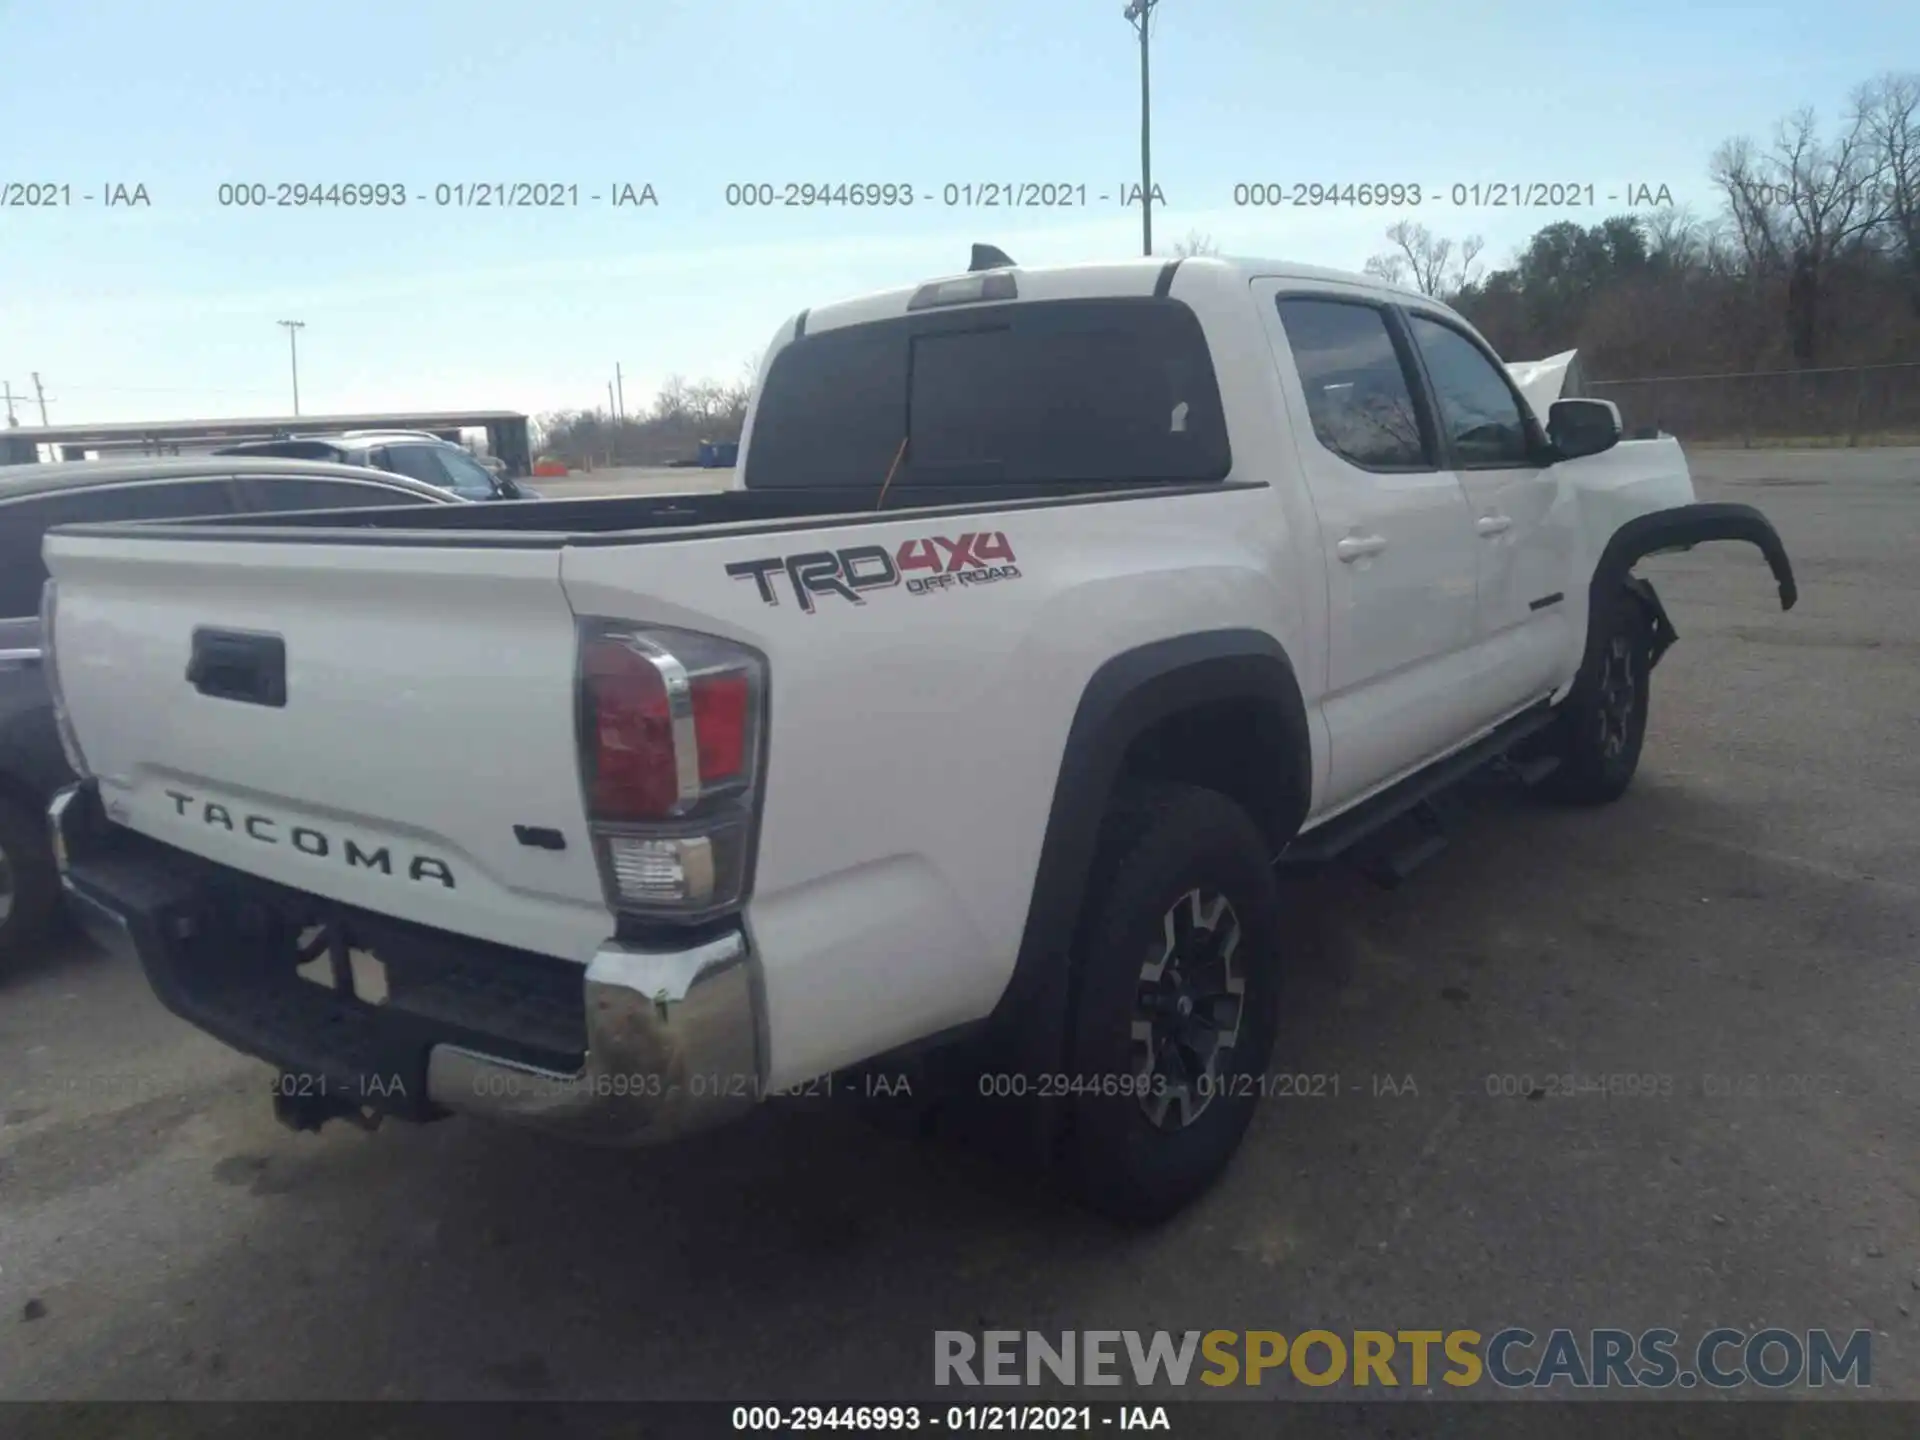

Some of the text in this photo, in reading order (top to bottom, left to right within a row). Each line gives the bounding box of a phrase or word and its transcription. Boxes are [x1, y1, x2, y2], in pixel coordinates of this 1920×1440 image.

[725, 545, 901, 614] TRD
[906, 566, 1022, 595] OFF ROAD
[165, 789, 456, 889] TACOMA
